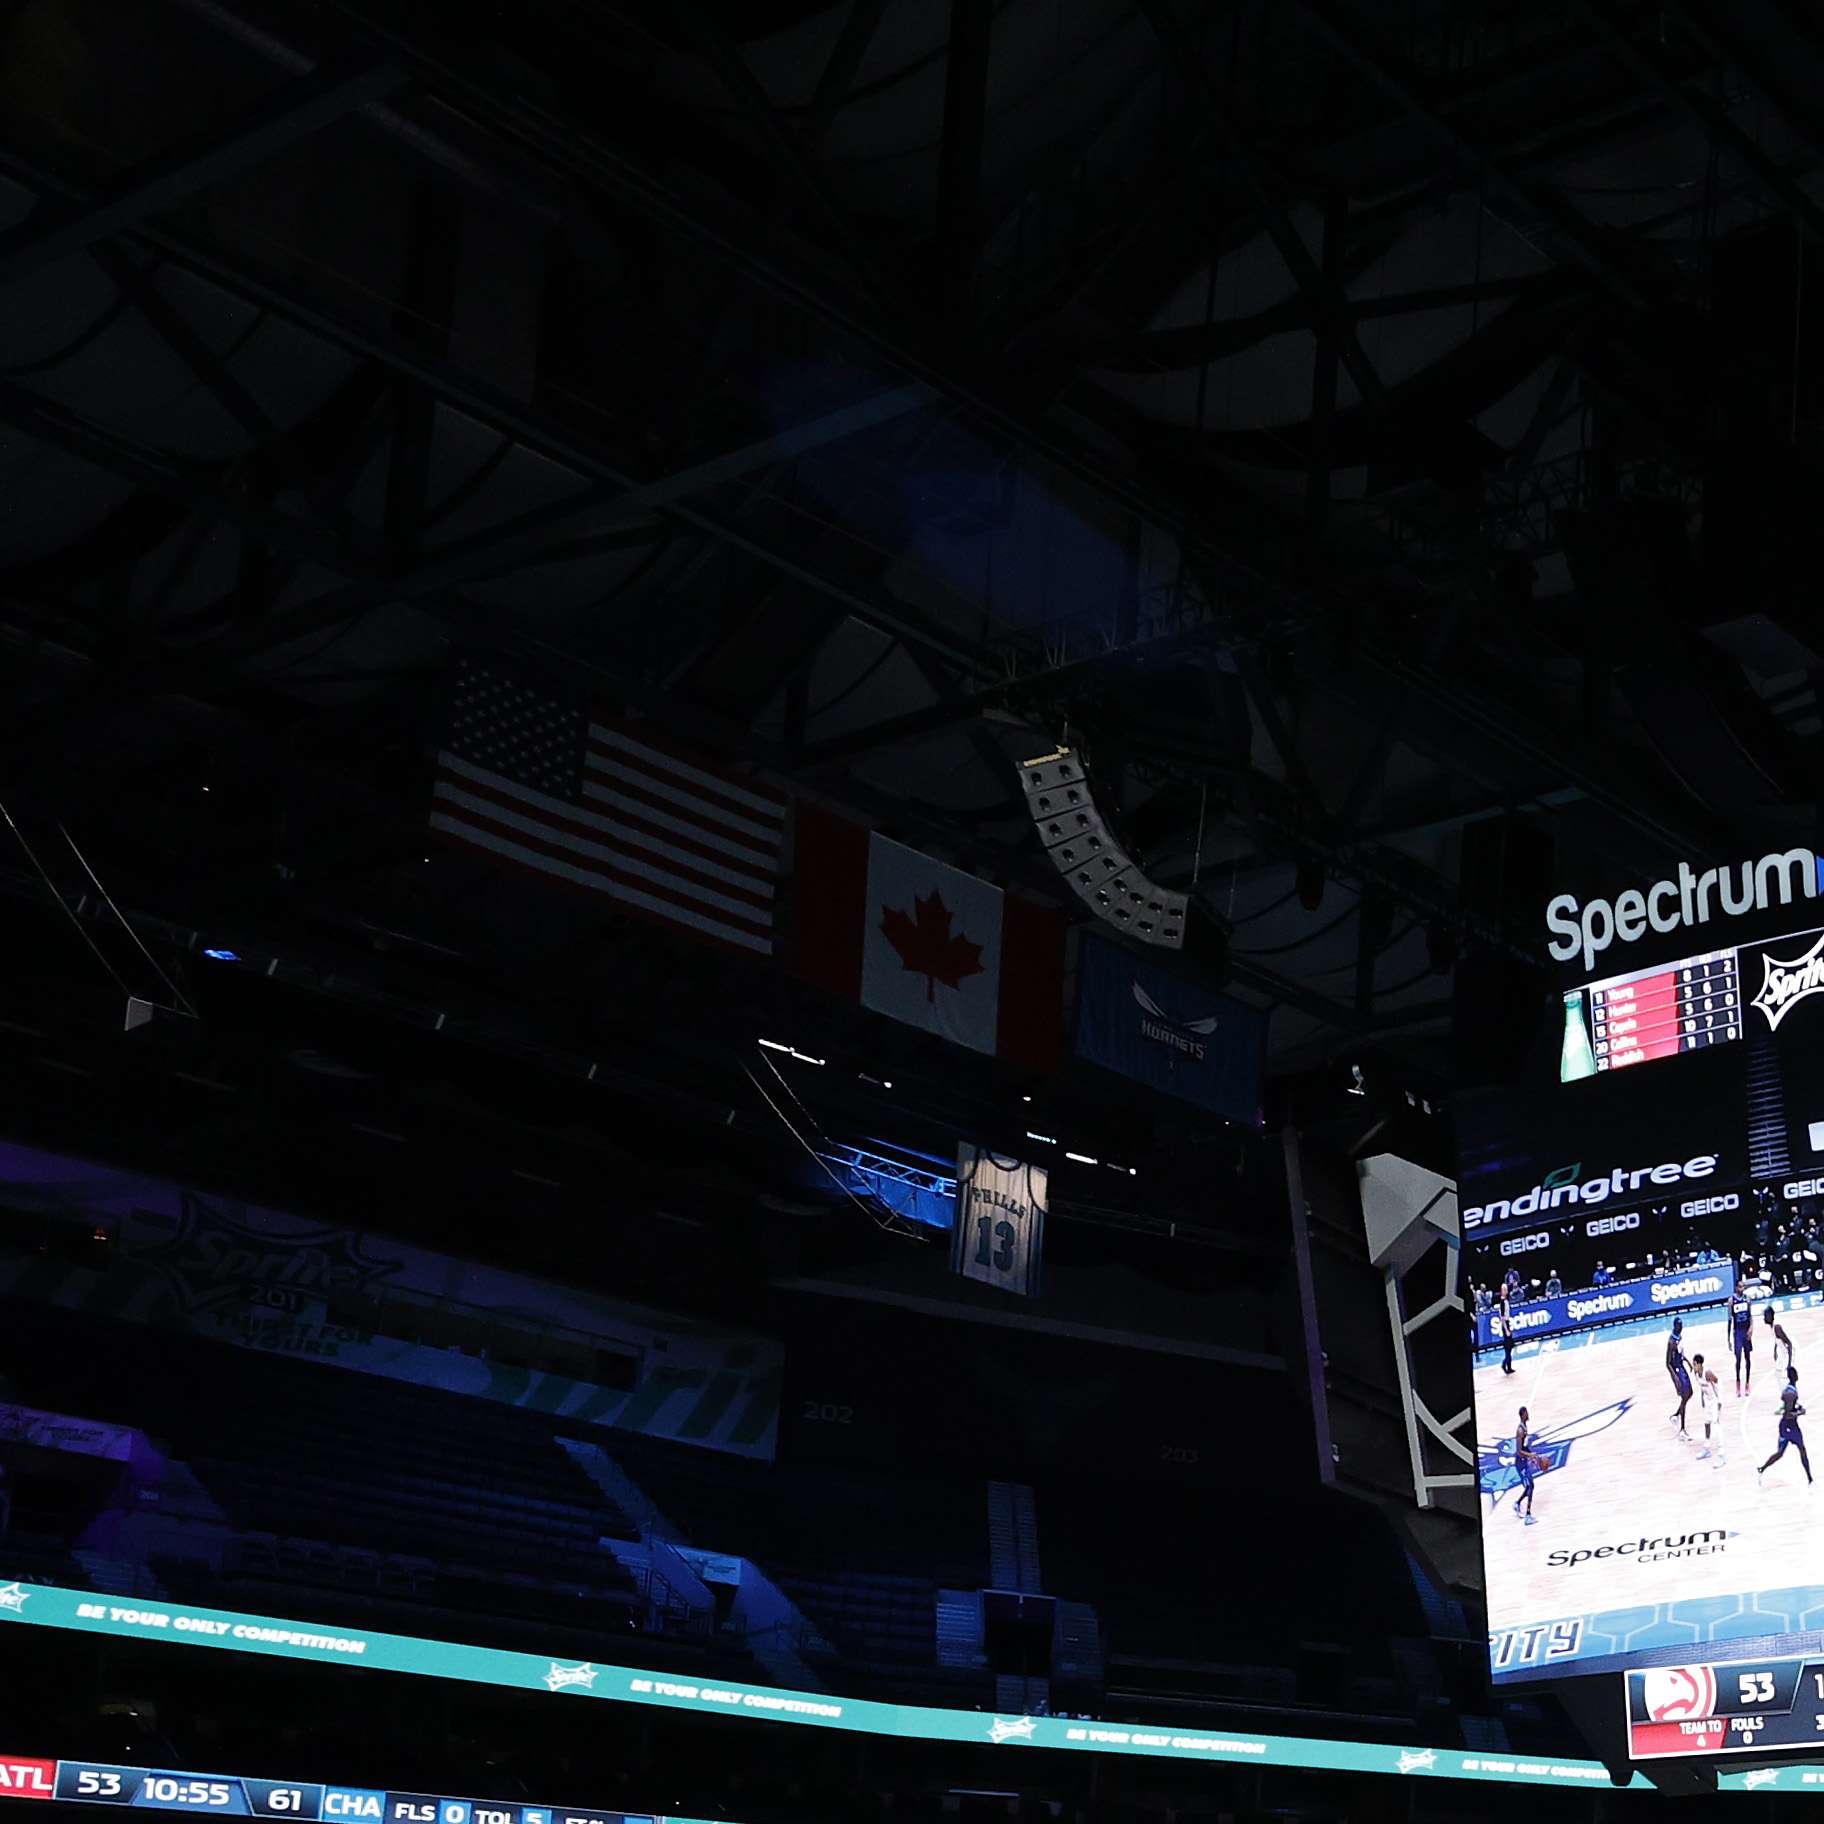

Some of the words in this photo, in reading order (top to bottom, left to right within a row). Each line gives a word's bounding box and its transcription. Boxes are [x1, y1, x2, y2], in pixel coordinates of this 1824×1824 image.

[1547, 848, 1817, 971] Spectrum
[1681, 1194, 1739, 1218] GEICO
[1586, 1212, 1640, 1236] GEICO
[975, 1216, 1015, 1272] 13
[1500, 1232, 1550, 1256] GEICO
[1650, 1277, 1718, 1306] Spectrum
[1568, 1293, 1630, 1321] Spectrum
[1547, 1530, 1726, 1567] Spectrum
[1637, 1545, 1725, 1563] CENTER
[76, 1604, 106, 1619] BE
[110, 1608, 170, 1627] YOUR
[173, 1617, 231, 1634] ONLY
[232, 1625, 366, 1653] COMPETITION
[1739, 1672, 1774, 1703] 53
[1680, 1722, 1704, 1735] TEAM
[1706, 1720, 1722, 1733] TO
[1731, 1716, 1763, 1732] FOULS
[77, 1771, 121, 1796] 53
[143, 1777, 229, 1806] 10:55
[268, 1789, 301, 1811] 61
[324, 1792, 381, 1817] CHA
[394, 1803, 436, 1821] FLS
[446, 1805, 463, 1824] 0
